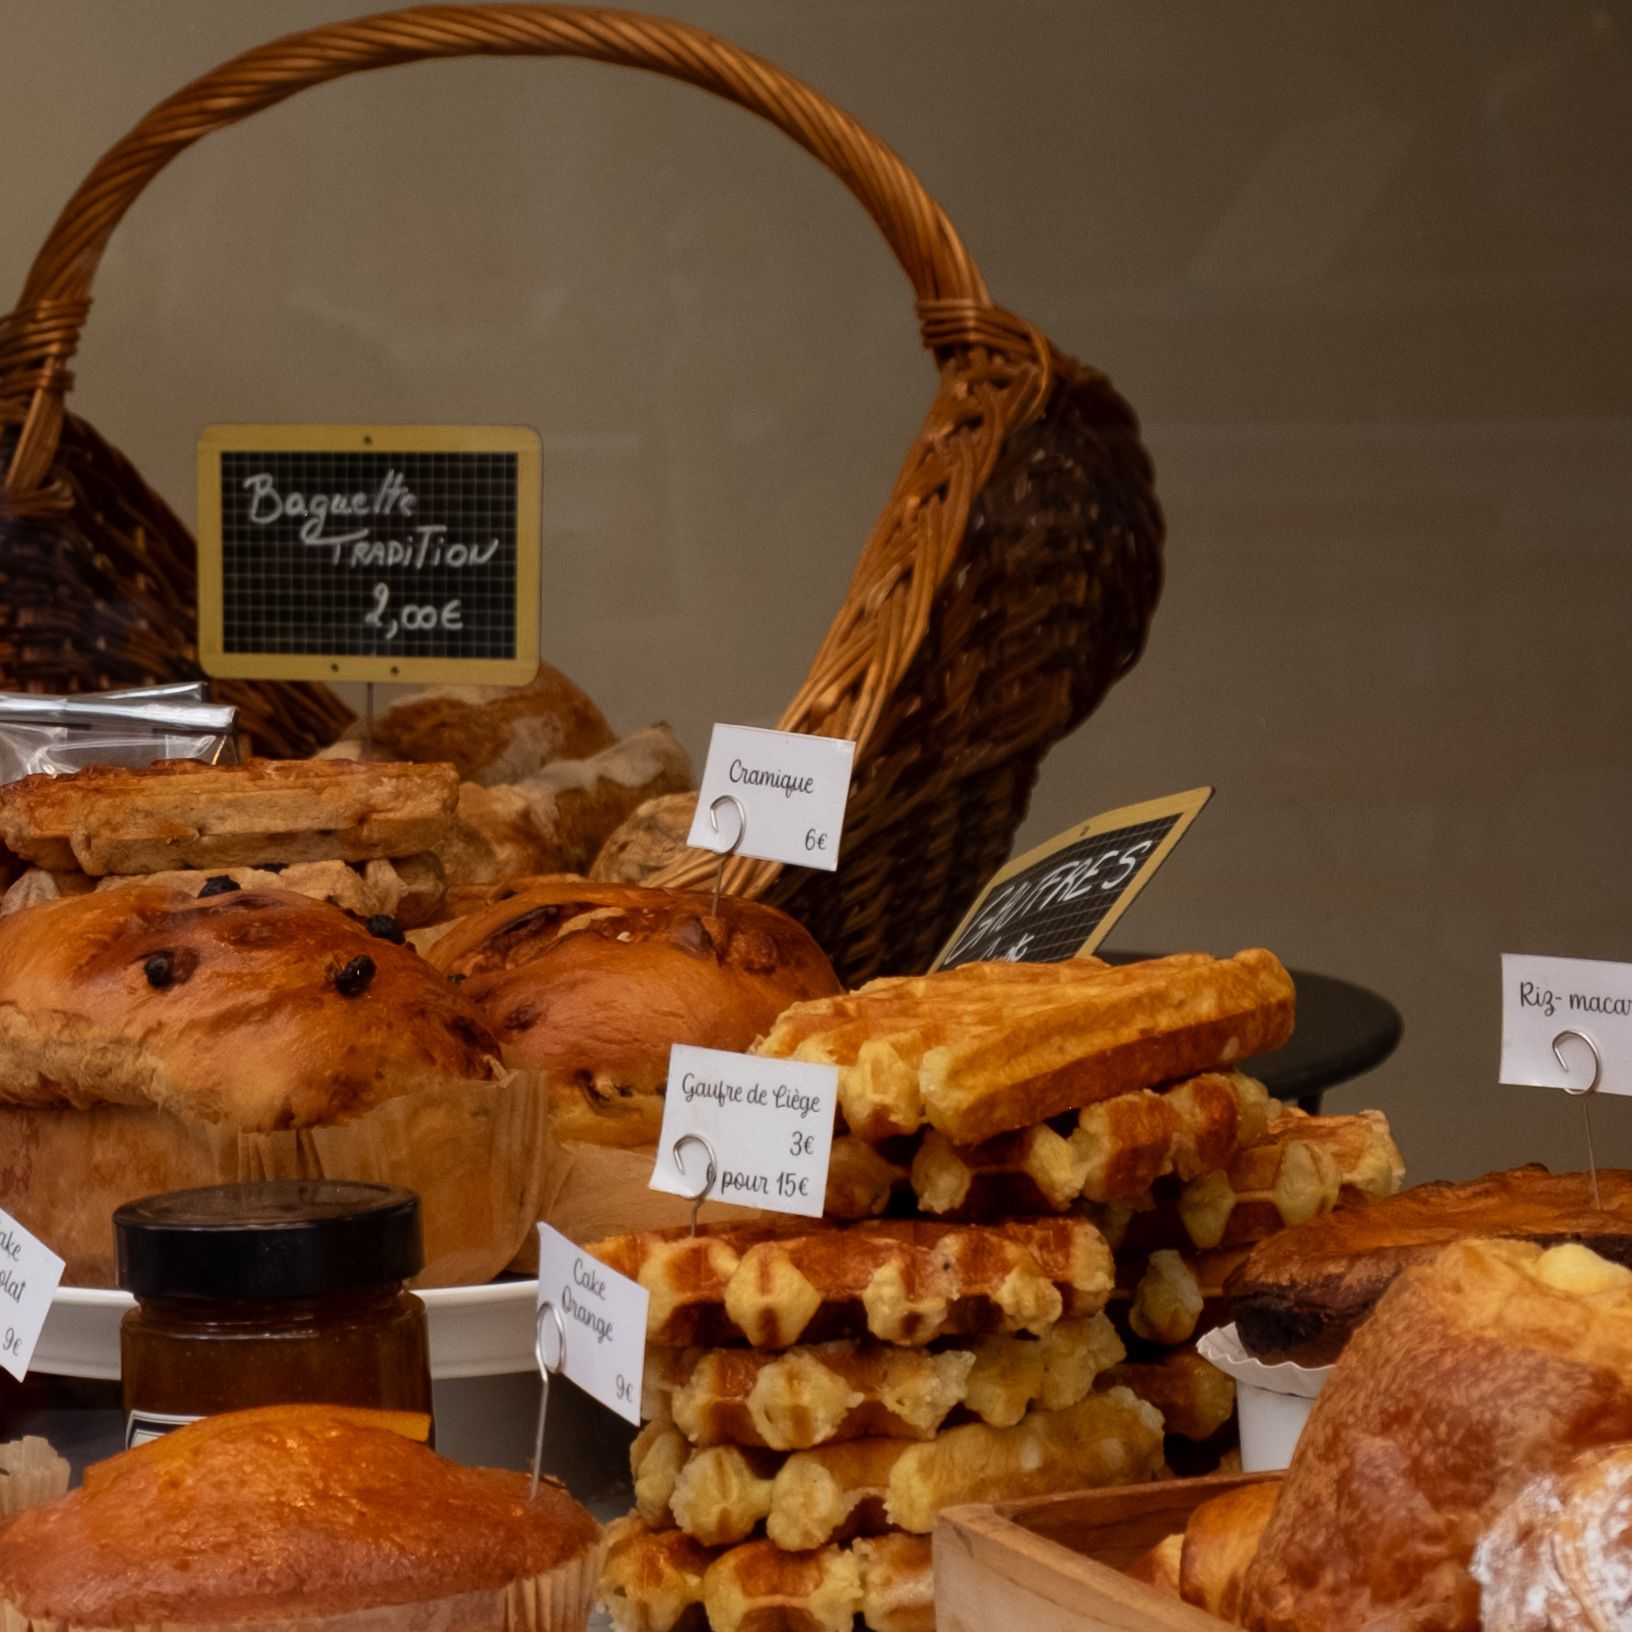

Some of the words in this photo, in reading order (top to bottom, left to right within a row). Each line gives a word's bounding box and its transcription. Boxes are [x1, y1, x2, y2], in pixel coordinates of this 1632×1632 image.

[244, 469, 418, 544] Baguette
[365, 582, 464, 640] 2,00€
[729, 758, 815, 799] Cramique
[804, 828, 829, 852] 6€
[682, 1072, 743, 1108] Gaufre
[746, 1083, 768, 1106] de
[772, 1084, 821, 1119] Liège
[789, 1130, 815, 1157] 3€
[721, 1170, 770, 1195] pour
[776, 1171, 810, 1198] 15€
[572, 1257, 607, 1301] Cake
[561, 1286, 614, 1345] Orange
[2, 1326, 23, 1357] 9€
[615, 1373, 634, 1404] 9€
